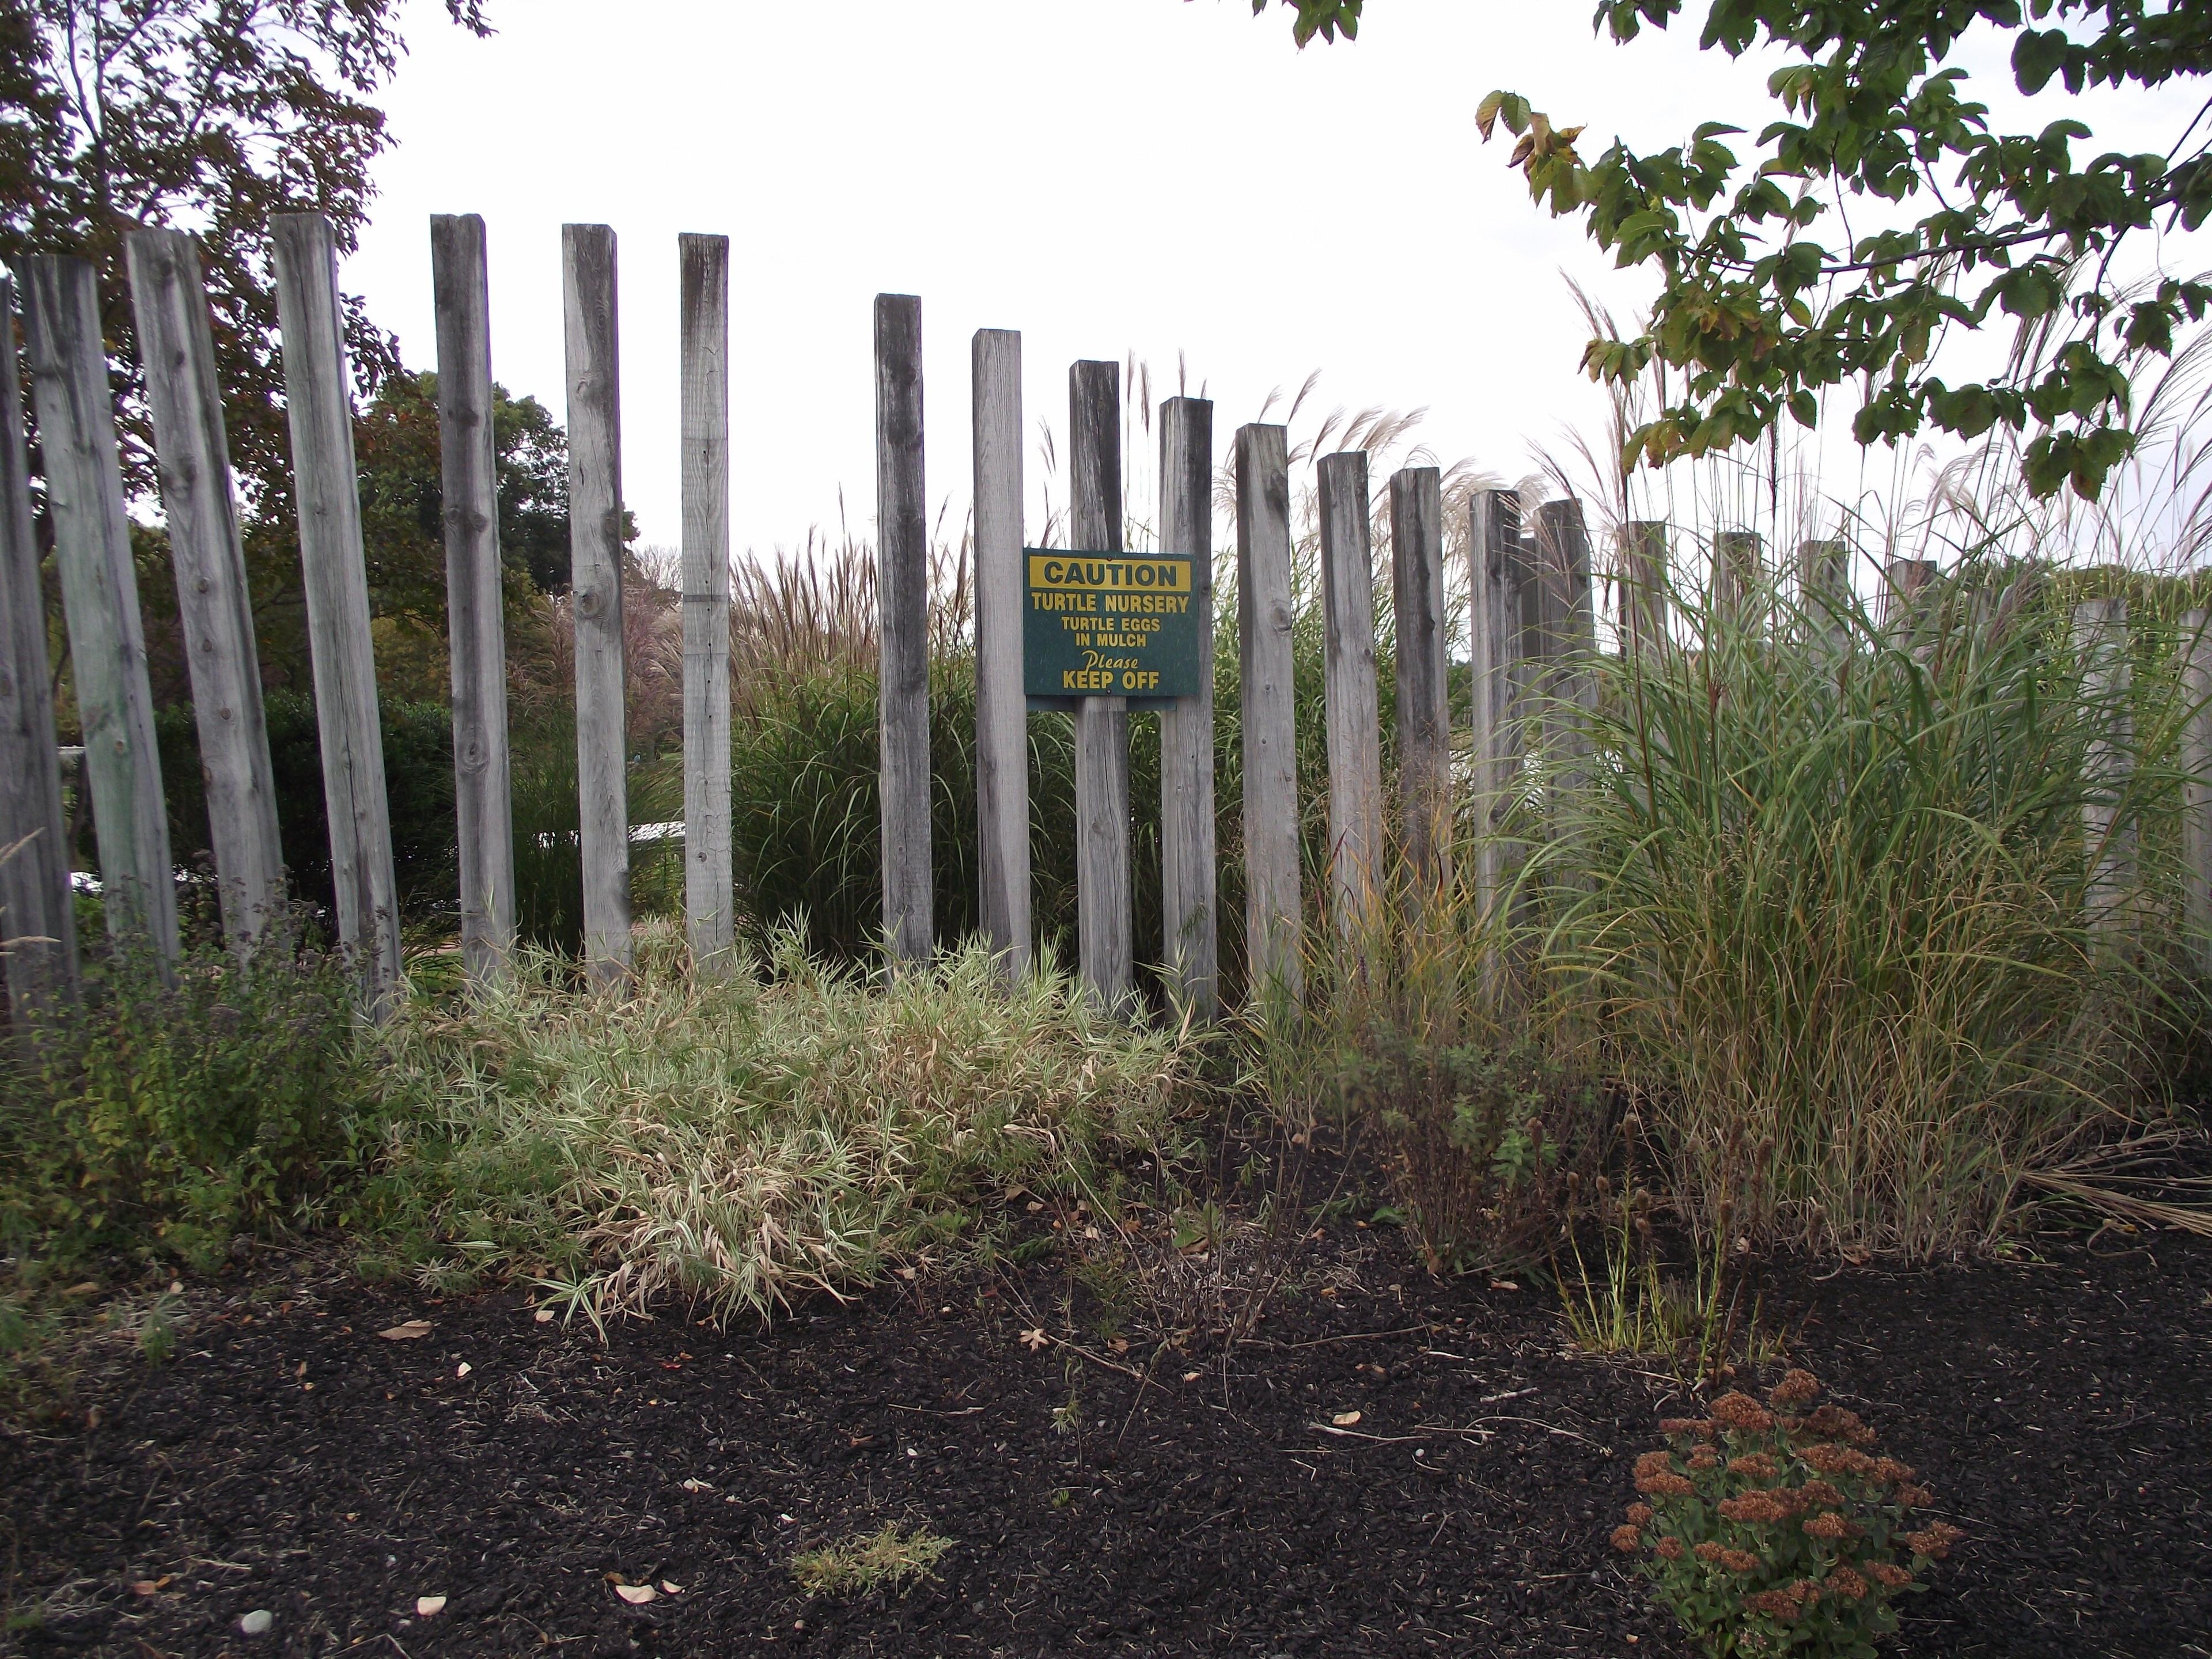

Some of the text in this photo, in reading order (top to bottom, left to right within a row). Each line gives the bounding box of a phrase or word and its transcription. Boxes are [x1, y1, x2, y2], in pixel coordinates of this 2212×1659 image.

[1044, 561, 1177, 587] CAUTION
[1031, 592, 1190, 613] TURTLE NURSERY
[1062, 616, 1161, 632] TURTLE EGGS
[1076, 632, 1146, 647] IN MULCH
[1082, 650, 1139, 673] Please
[1063, 671, 1159, 689] KEEP OFF
